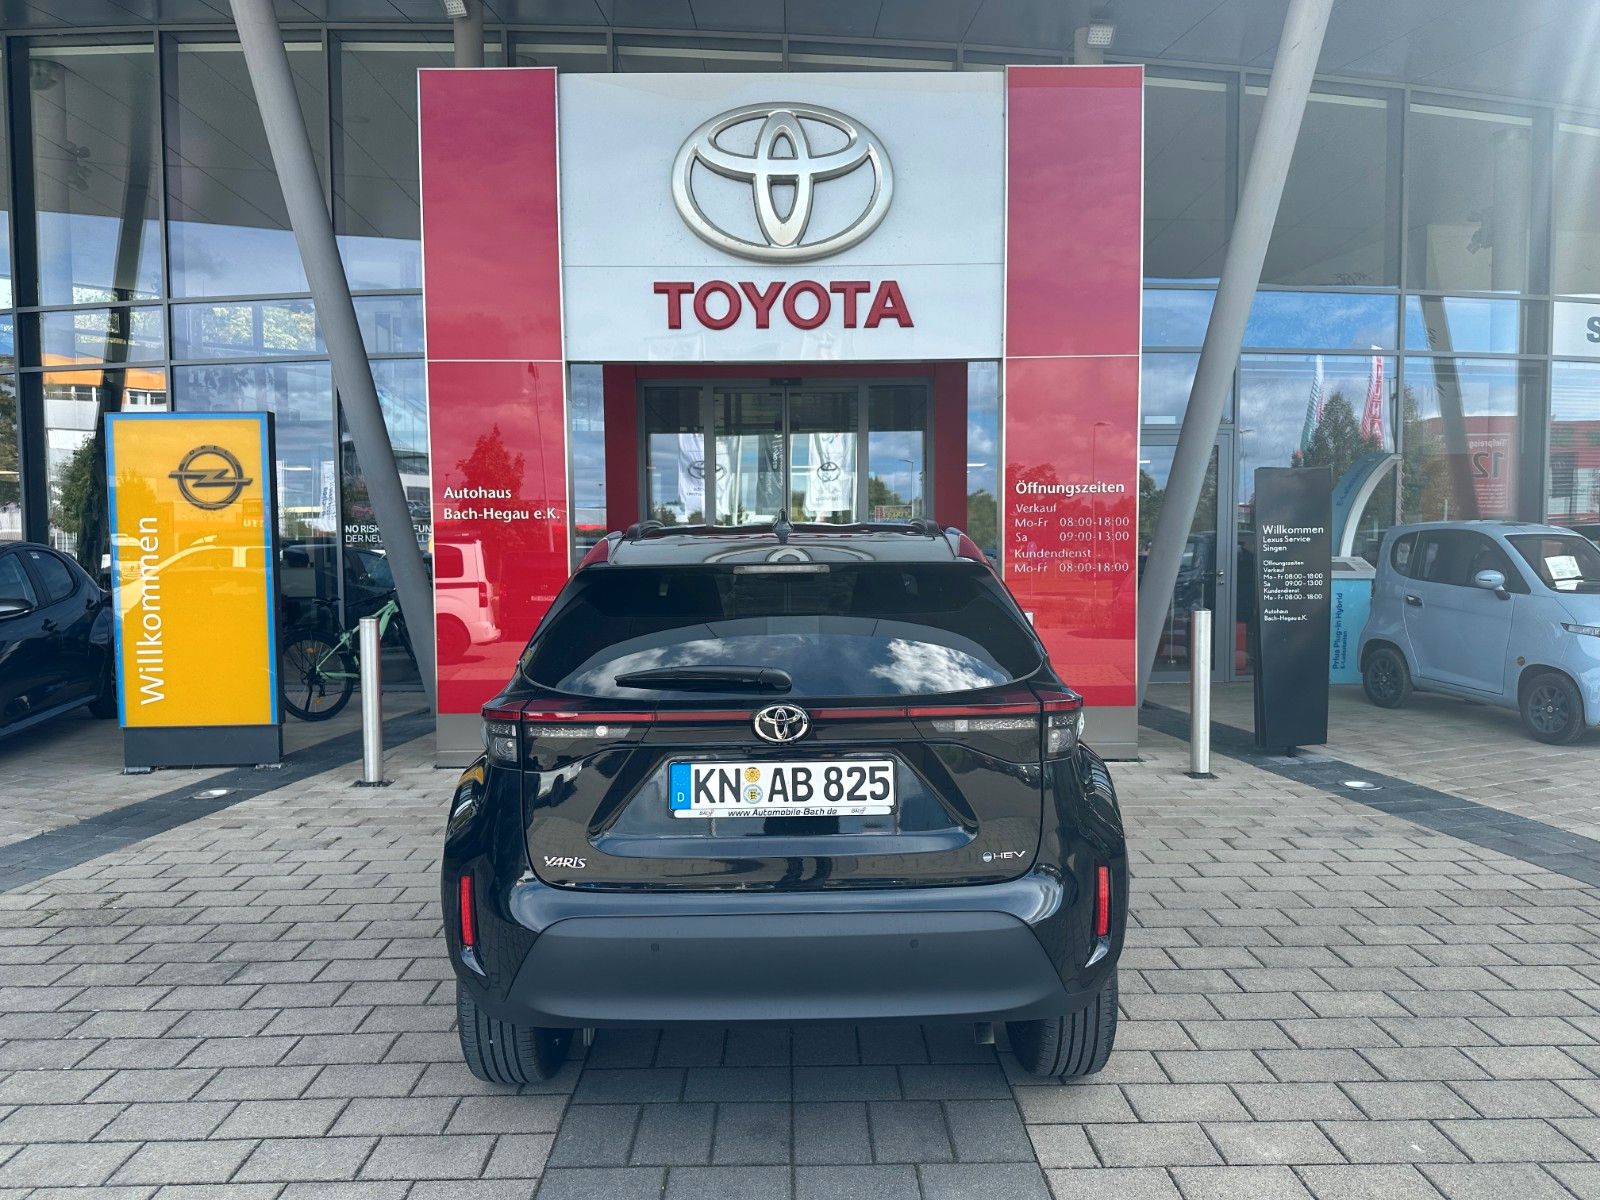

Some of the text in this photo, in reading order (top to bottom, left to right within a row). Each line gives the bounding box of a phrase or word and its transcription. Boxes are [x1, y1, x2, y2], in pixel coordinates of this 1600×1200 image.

[653, 280, 914, 331] TOYOTA
[443, 486, 512, 499] Autohaus
[1015, 480, 1125, 497] Öffnungszeiten
[1015, 503, 1057, 513] Verkauf
[443, 507, 560, 523] Bach-Hegau e.K.
[1014, 517, 1130, 528] Mo-Fr 08:00-18:00
[345, 525, 359, 534] NO
[1262, 524, 1324, 534] Willkommen
[345, 534, 363, 543] DER
[1015, 532, 1130, 542] Sa 09:00-13:00
[1284, 535, 1311, 543] Service
[1262, 544, 1287, 552] Singen
[1014, 549, 1091, 559] Kundendienst
[1014, 563, 1129, 573] Mo-Fr 08:00-18:00
[136, 517, 165, 706] Willkommen
[694, 766, 890, 803] KN AB 825
[677, 792, 685, 802] D
[993, 850, 1026, 859] HEV
[543, 855, 587, 869] YARIS
